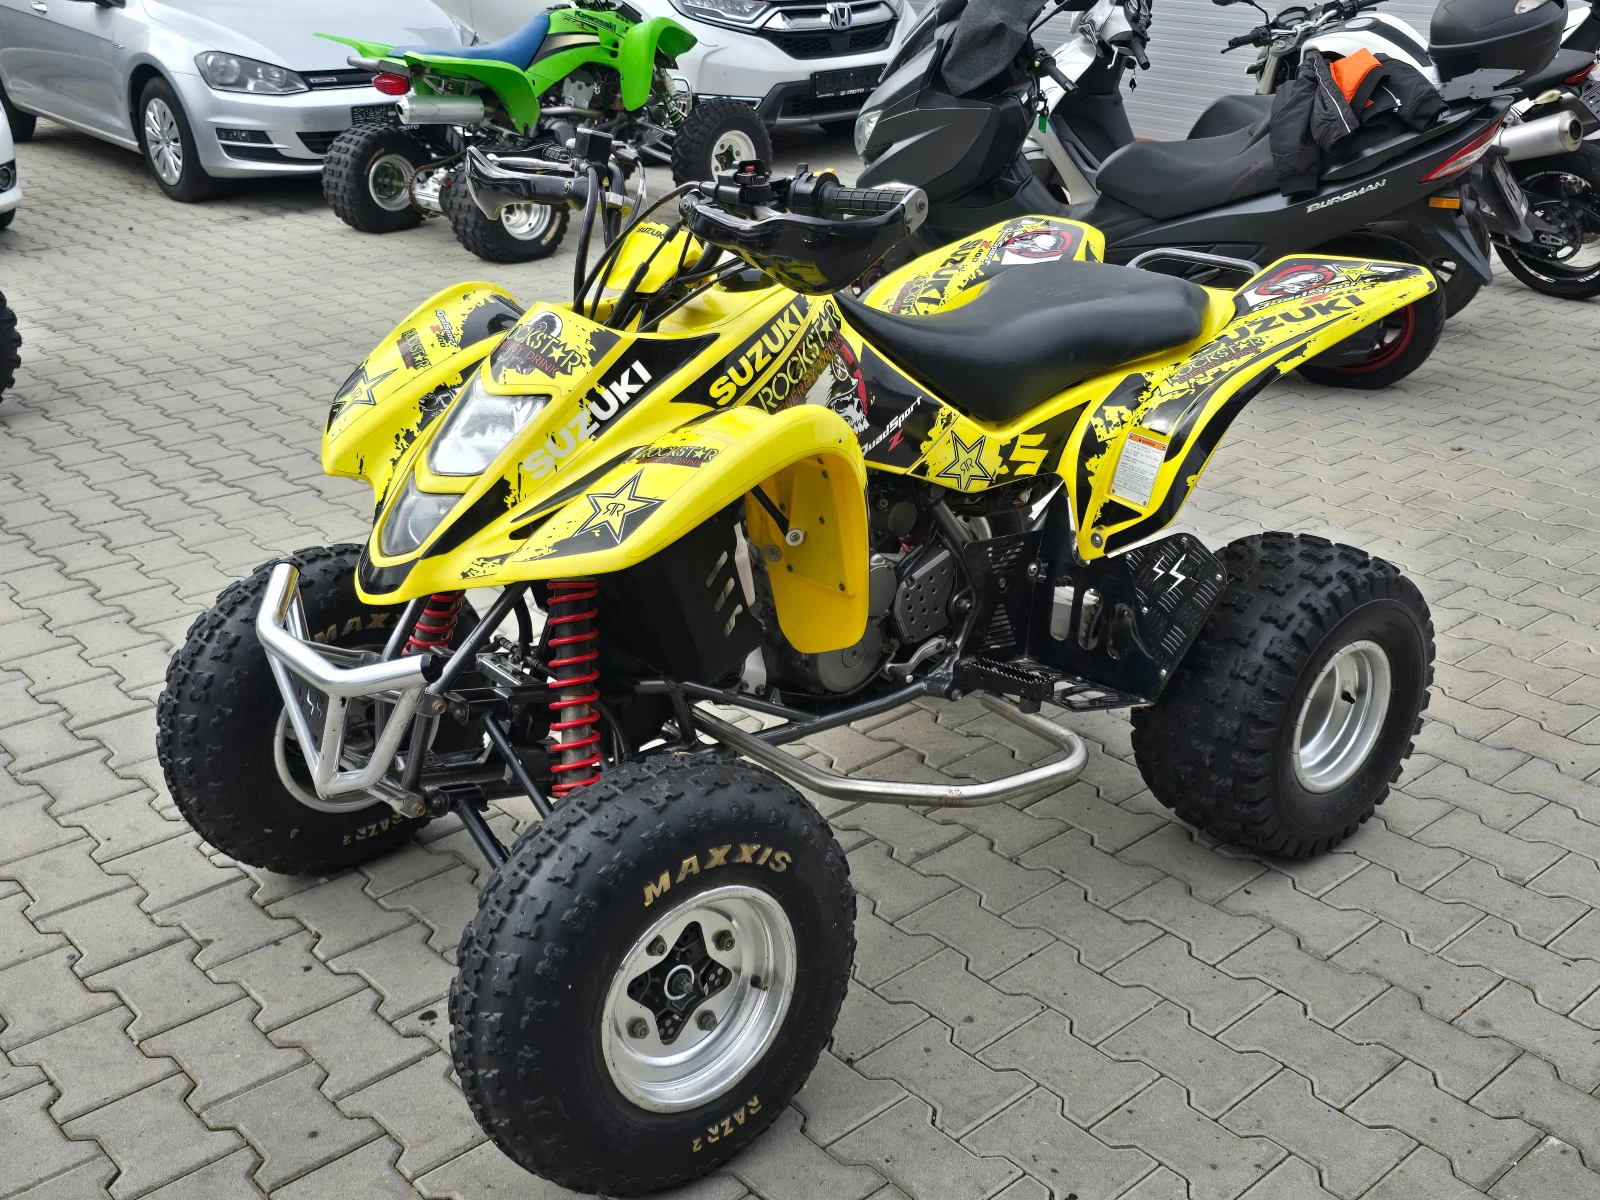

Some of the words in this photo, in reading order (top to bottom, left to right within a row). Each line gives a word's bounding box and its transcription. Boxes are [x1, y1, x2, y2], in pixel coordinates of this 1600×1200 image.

[574, 11, 617, 32] Kawasaki
[1306, 179, 1387, 213] BURGMAN
[636, 227, 666, 240] SUZUK
[917, 239, 983, 306] SUZUKI
[525, 350, 560, 377] DRINK
[709, 302, 806, 406] SUZUKI
[758, 299, 841, 415] ROCKSTAR
[819, 333, 842, 368] DRINK
[522, 359, 653, 479] SUZUKI
[860, 395, 923, 457] QuadSport
[673, 458, 704, 468] DRINK
[643, 843, 793, 907] MAXXIS
